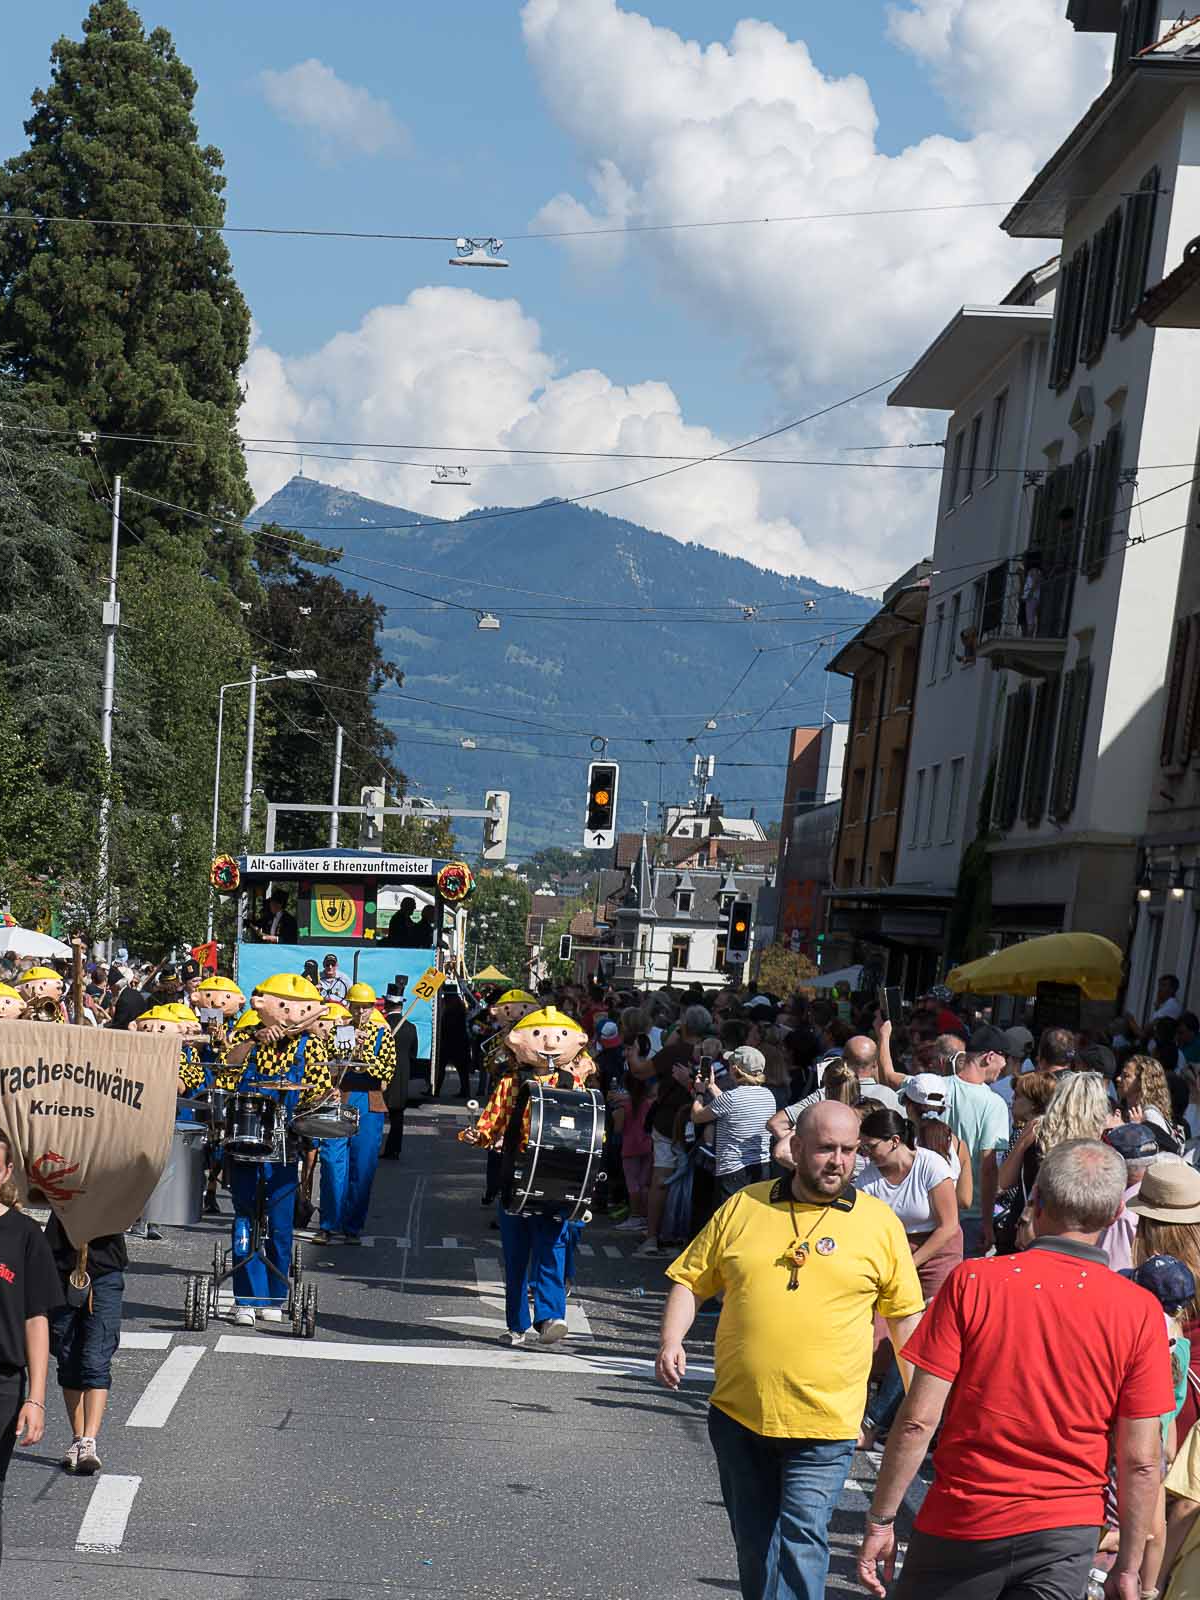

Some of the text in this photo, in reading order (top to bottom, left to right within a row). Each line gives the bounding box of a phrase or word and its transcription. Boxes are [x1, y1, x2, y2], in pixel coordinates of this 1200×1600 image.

[250, 859, 429, 873] Alt-Galliväter & Ehrenzunftmeister
[416, 982, 434, 997] 20
[30, 1099, 96, 1118] Kriens
